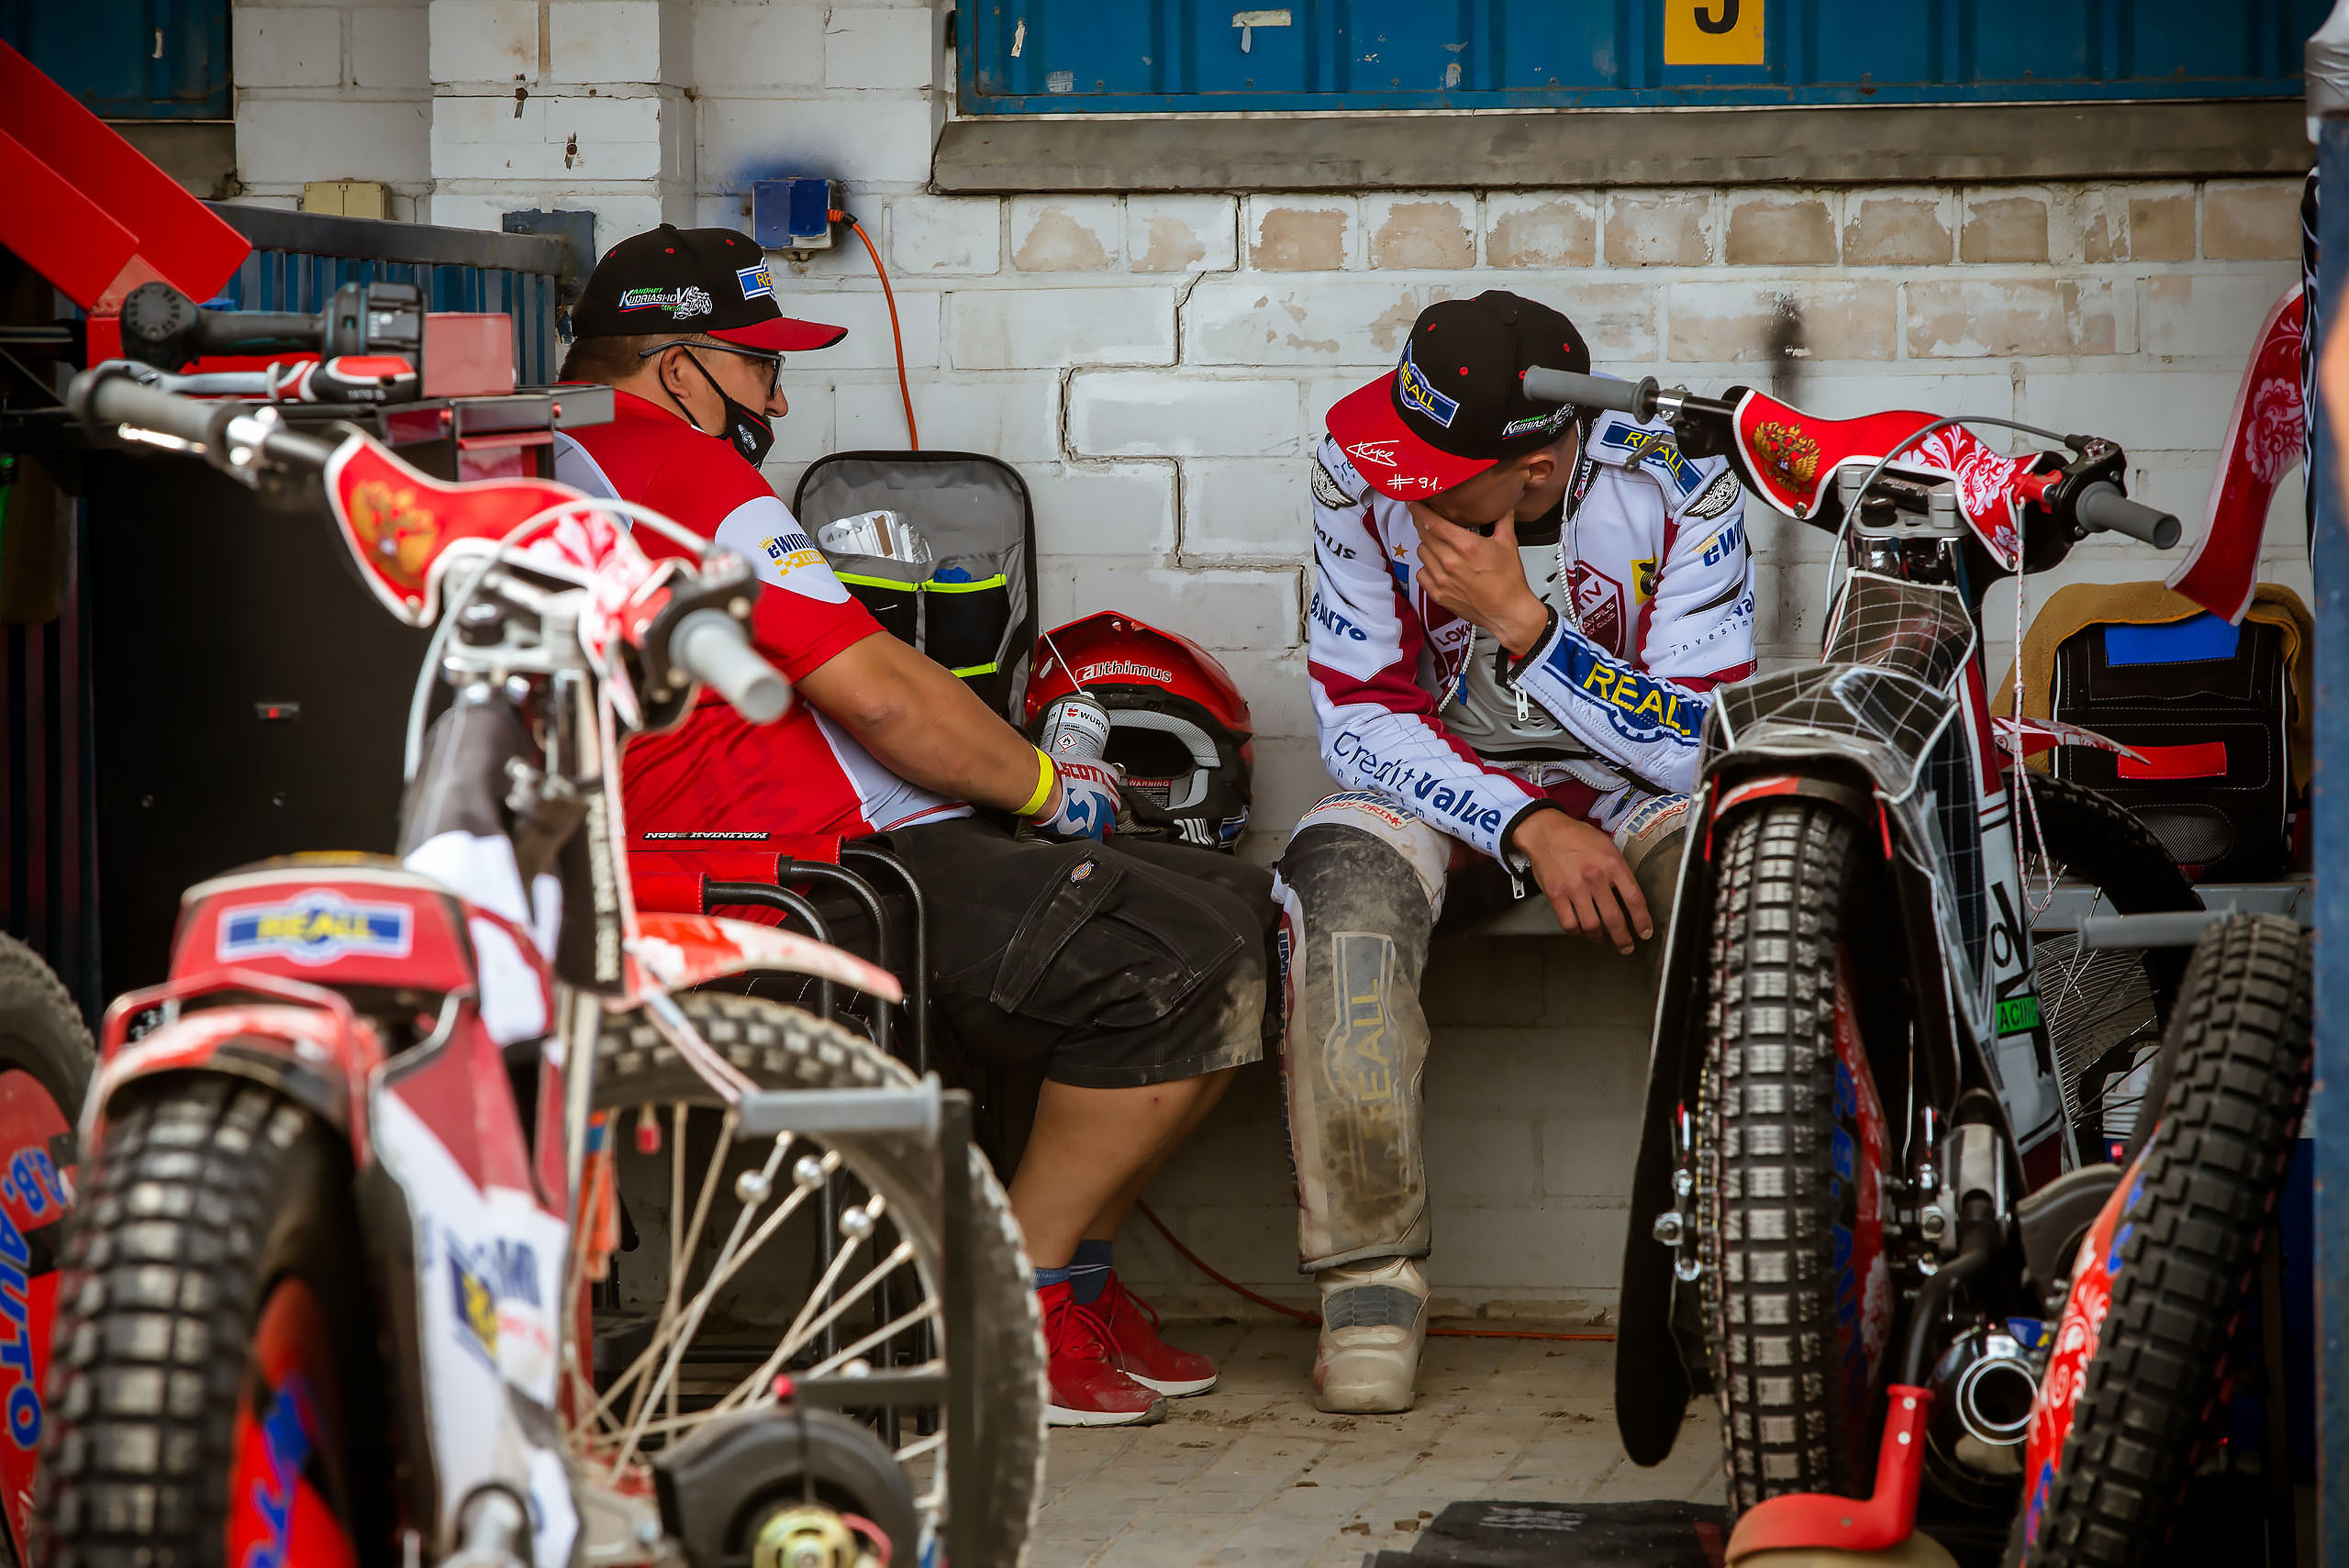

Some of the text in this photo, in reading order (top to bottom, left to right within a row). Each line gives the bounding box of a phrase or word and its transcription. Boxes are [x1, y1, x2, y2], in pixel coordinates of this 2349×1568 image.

[1400, 361, 1435, 411] REALL
[1078, 660, 1172, 683] althimus
[1333, 731, 1416, 793] Credit
[1414, 772, 1502, 835] Value
